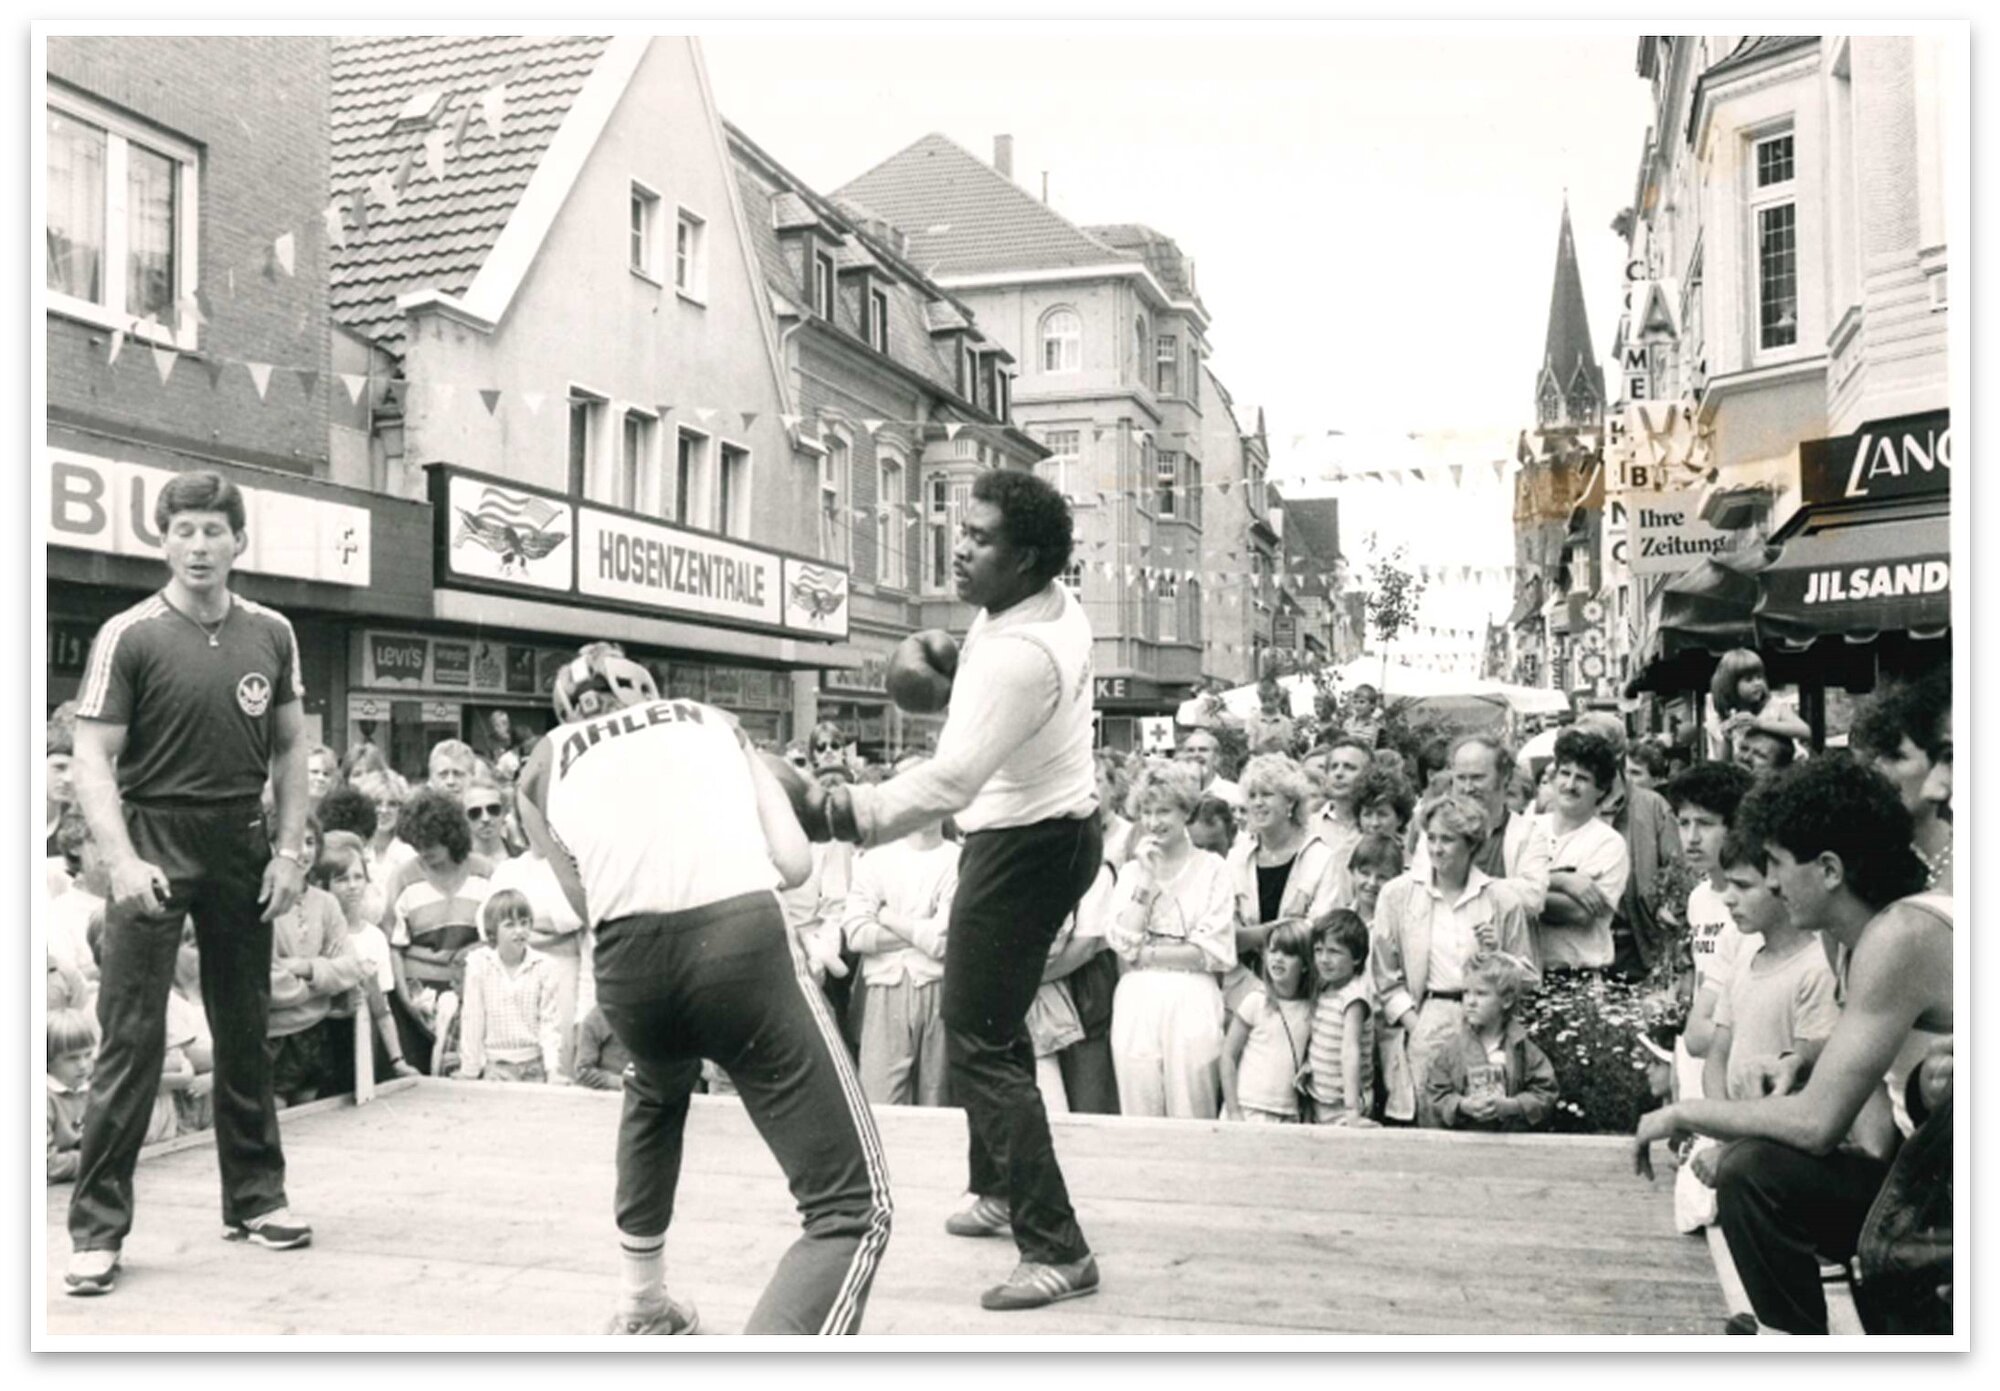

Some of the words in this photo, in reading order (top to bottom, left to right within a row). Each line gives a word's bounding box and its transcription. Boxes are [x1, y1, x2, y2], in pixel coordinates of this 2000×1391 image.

[1639, 509, 1684, 528] Ihre
[598, 529, 765, 607] HOSENZENTRALE
[1641, 535, 1726, 557] Zeitung
[560, 703, 704, 781] AHLEN
